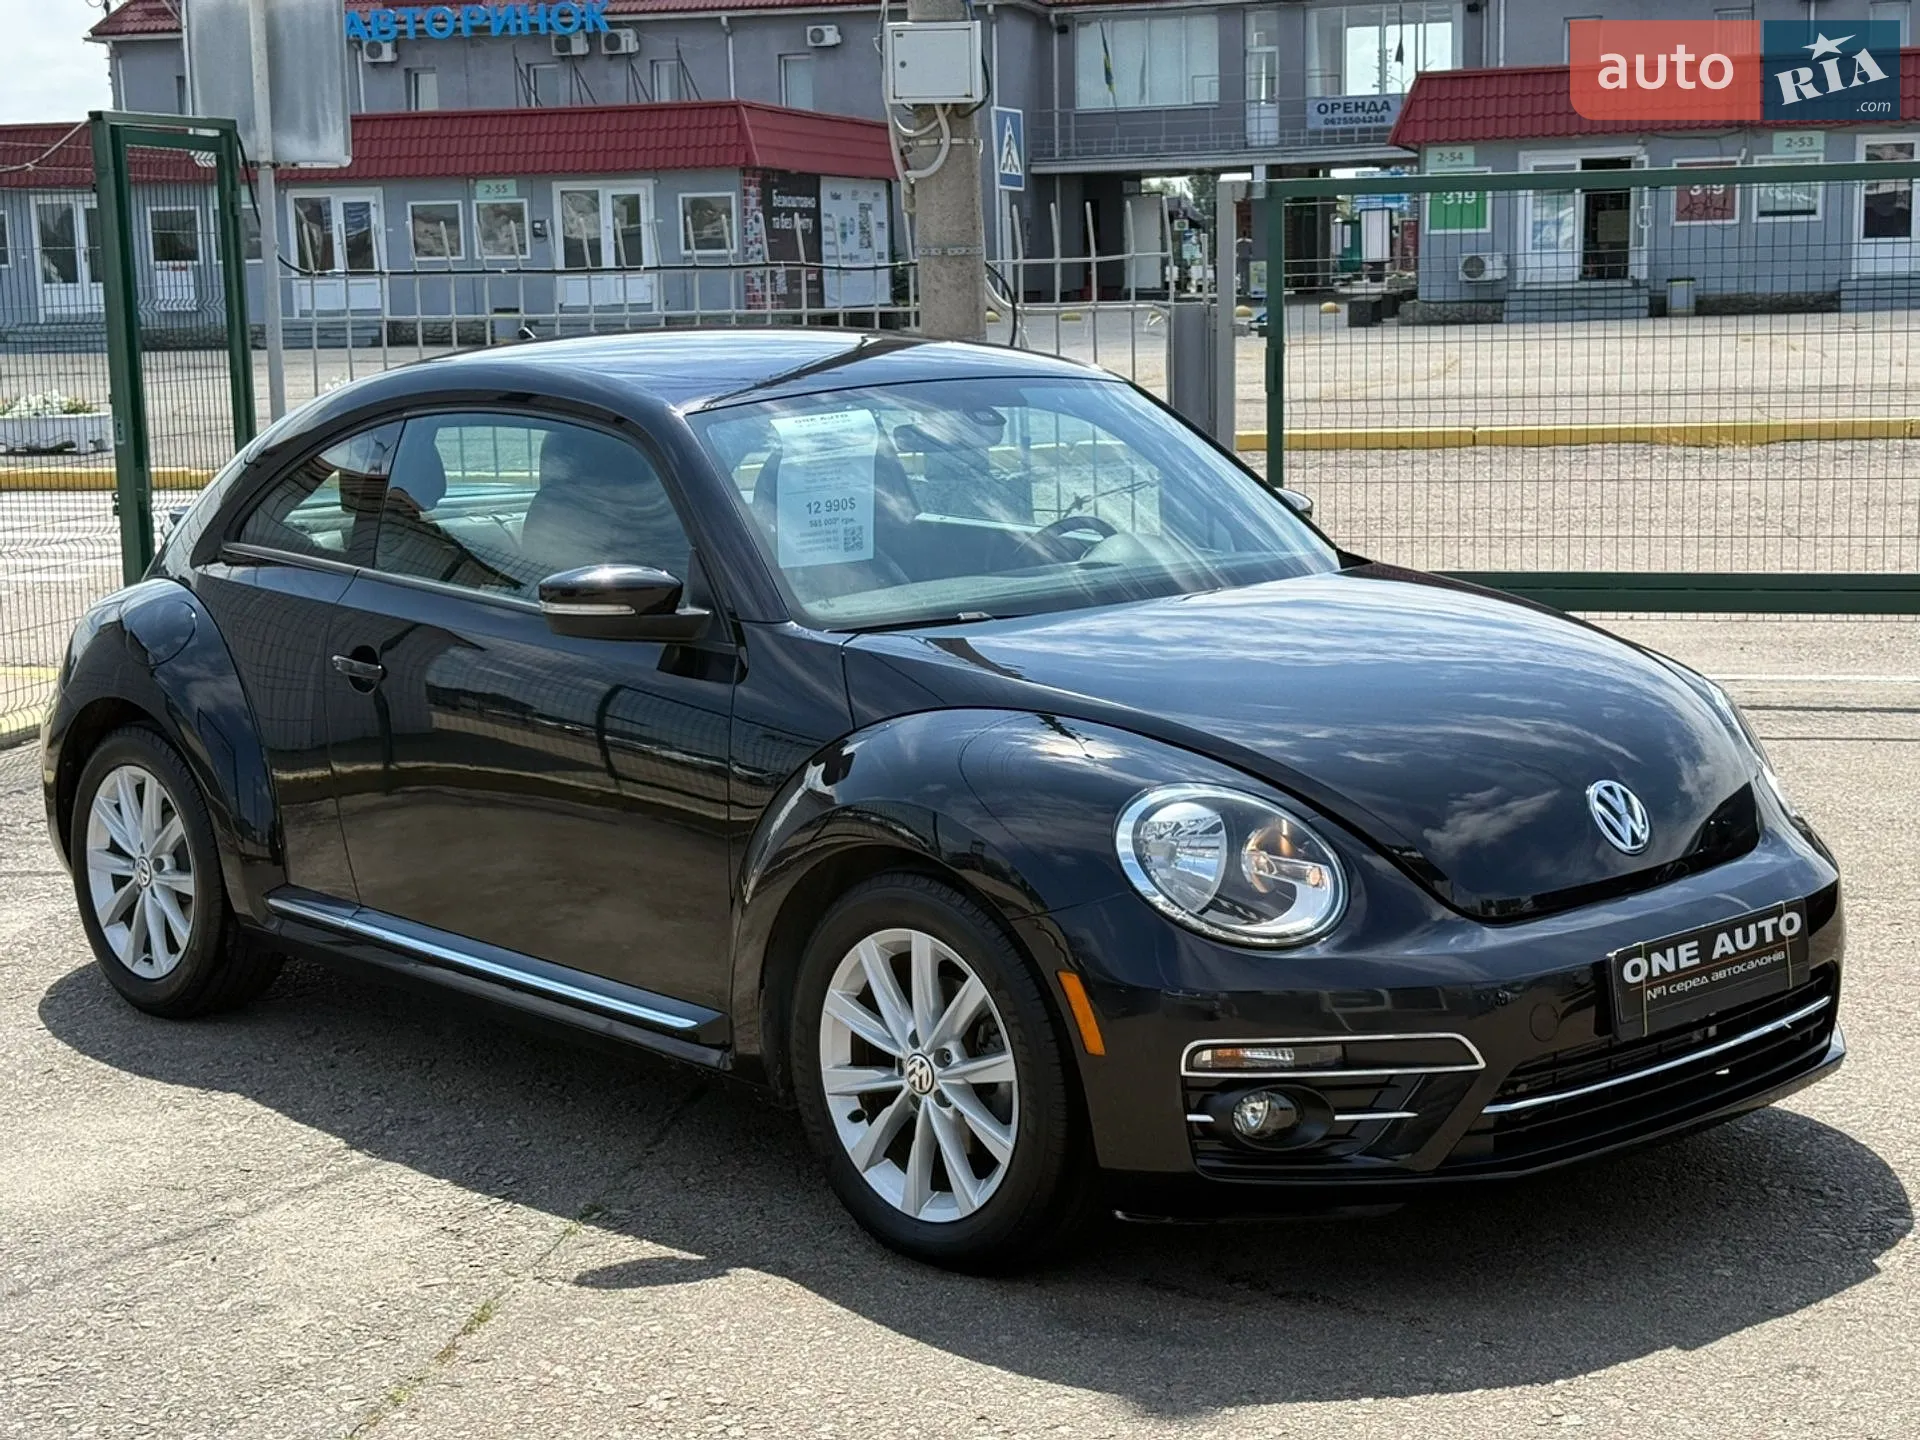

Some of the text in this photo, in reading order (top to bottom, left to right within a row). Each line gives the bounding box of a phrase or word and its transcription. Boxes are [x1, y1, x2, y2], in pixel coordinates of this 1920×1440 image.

[344, 1, 609, 42] АВТОРИНОК
[1317, 100, 1392, 115] ОРЕНДА
[1785, 137, 1814, 148] 2-53
[1437, 152, 1464, 162] 2-54
[806, 497, 856, 515] 12 990$
[1622, 911, 1802, 984] ONE AUTO
[1670, 974, 1709, 994] серед
[1711, 950, 1786, 982] автосалонів
